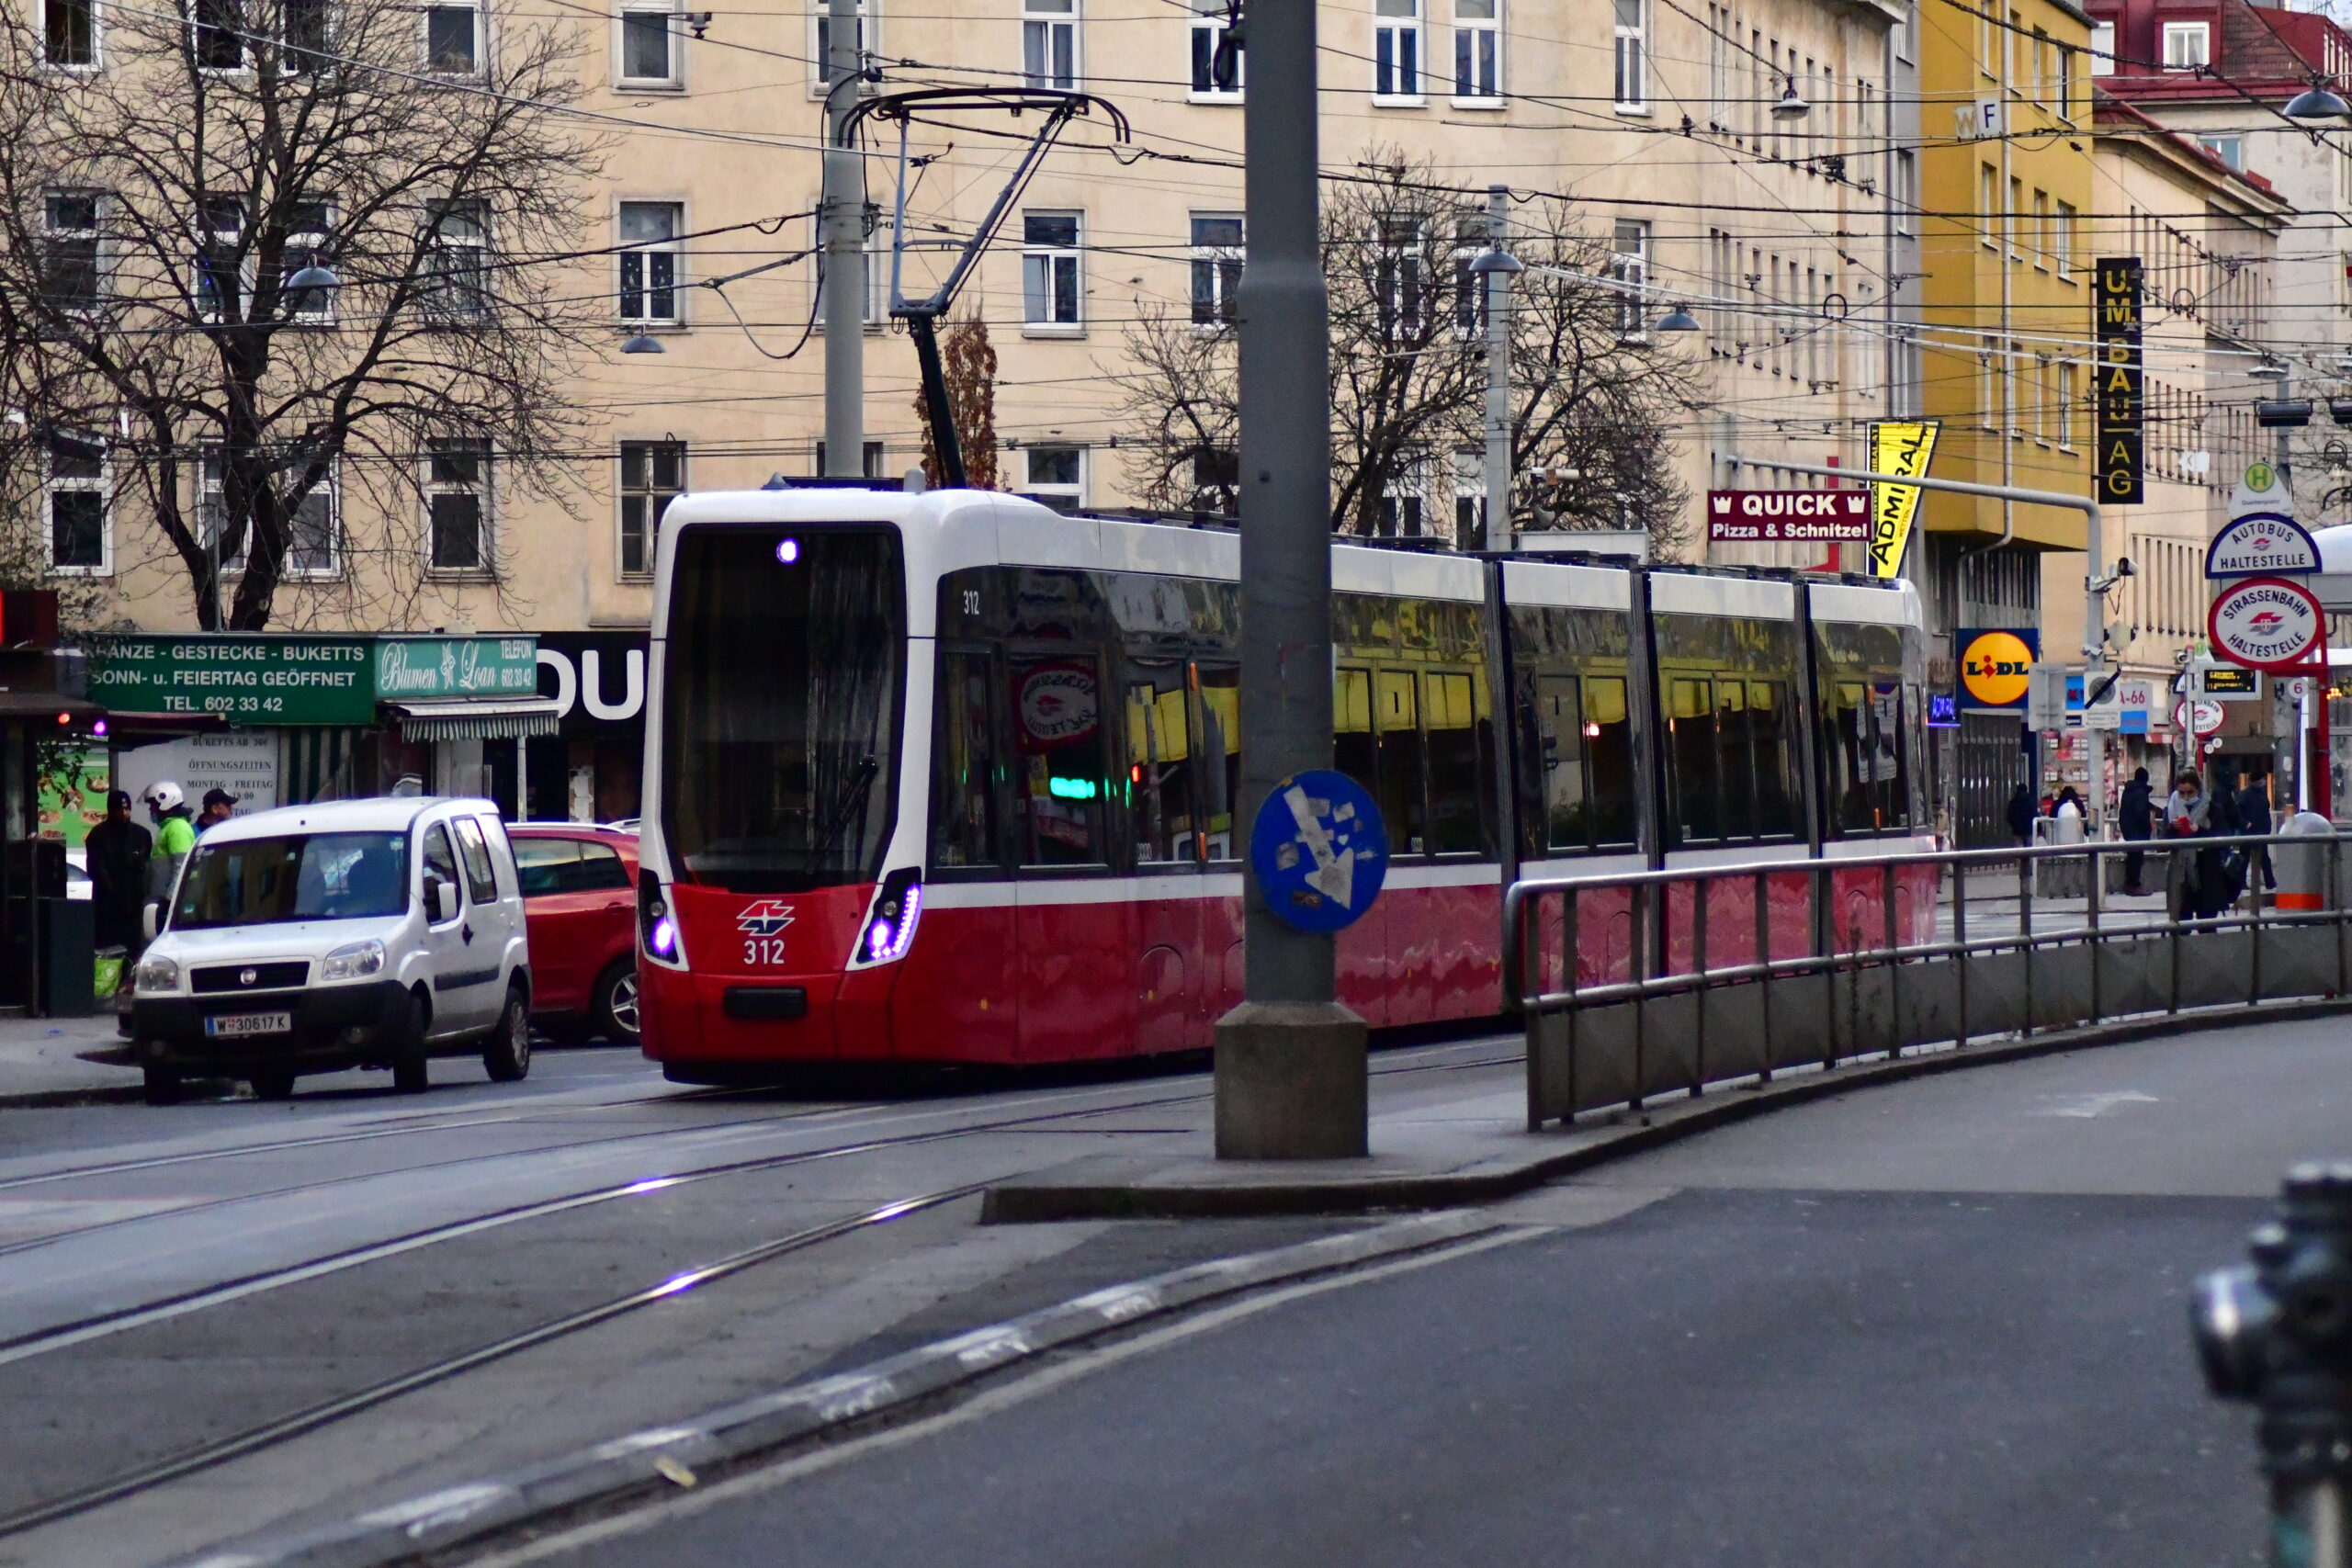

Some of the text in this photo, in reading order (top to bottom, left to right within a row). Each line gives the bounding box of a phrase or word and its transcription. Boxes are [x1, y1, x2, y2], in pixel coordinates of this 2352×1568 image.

[1871, 423, 1928, 567] ADMIRAL
[1742, 494, 1838, 517] QUICK
[1713, 523, 1868, 538] Pizza & Schnitzel
[2231, 522, 2294, 545] AUTOBUS
[2220, 553, 2306, 570] HALTESTELLE
[963, 589, 980, 615] 312
[2223, 589, 2310, 620] STRASSENBAHN
[172, 645, 266, 660] GESTECKE
[283, 646, 365, 661] BUKETTS
[500, 640, 532, 660] TELEFON
[2227, 631, 2306, 658] HALTESTELLE
[380, 642, 438, 692] Blumen
[153, 672, 168, 685] u.
[174, 671, 257, 686] FEIERTAG
[262, 668, 356, 687] GEÖFFNET
[2293, 682, 2302, 694] 6
[163, 695, 283, 712] TEL. 602 33 42
[188, 758, 272, 771] ÖFFNUNGSZEITEN
[187, 780, 226, 788] MONTAG
[234, 780, 274, 789] FREITAG
[743, 939, 785, 964] 312
